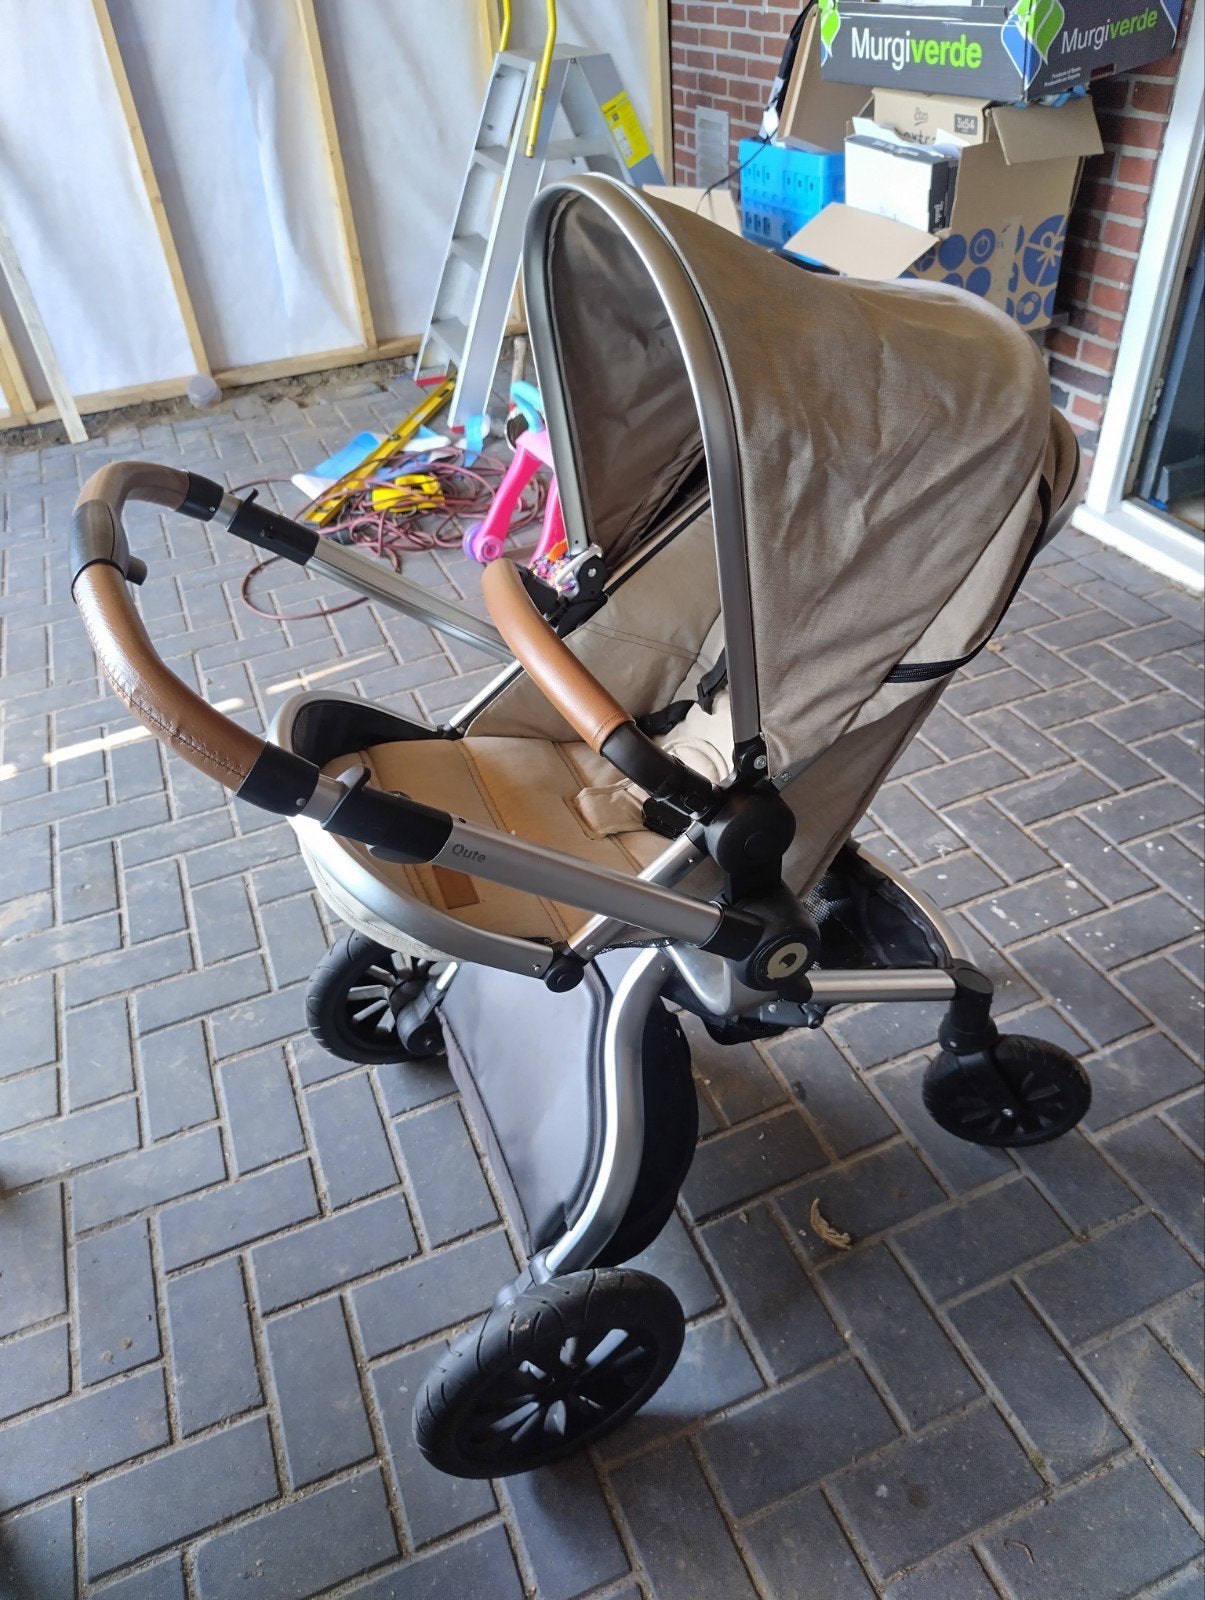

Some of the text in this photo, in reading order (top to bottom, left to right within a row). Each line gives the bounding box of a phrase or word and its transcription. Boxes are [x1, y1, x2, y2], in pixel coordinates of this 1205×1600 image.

[851, 26, 983, 71] Murgiverde
[1061, 8, 1158, 54] Murgiverde
[452, 843, 486, 863] Qute
